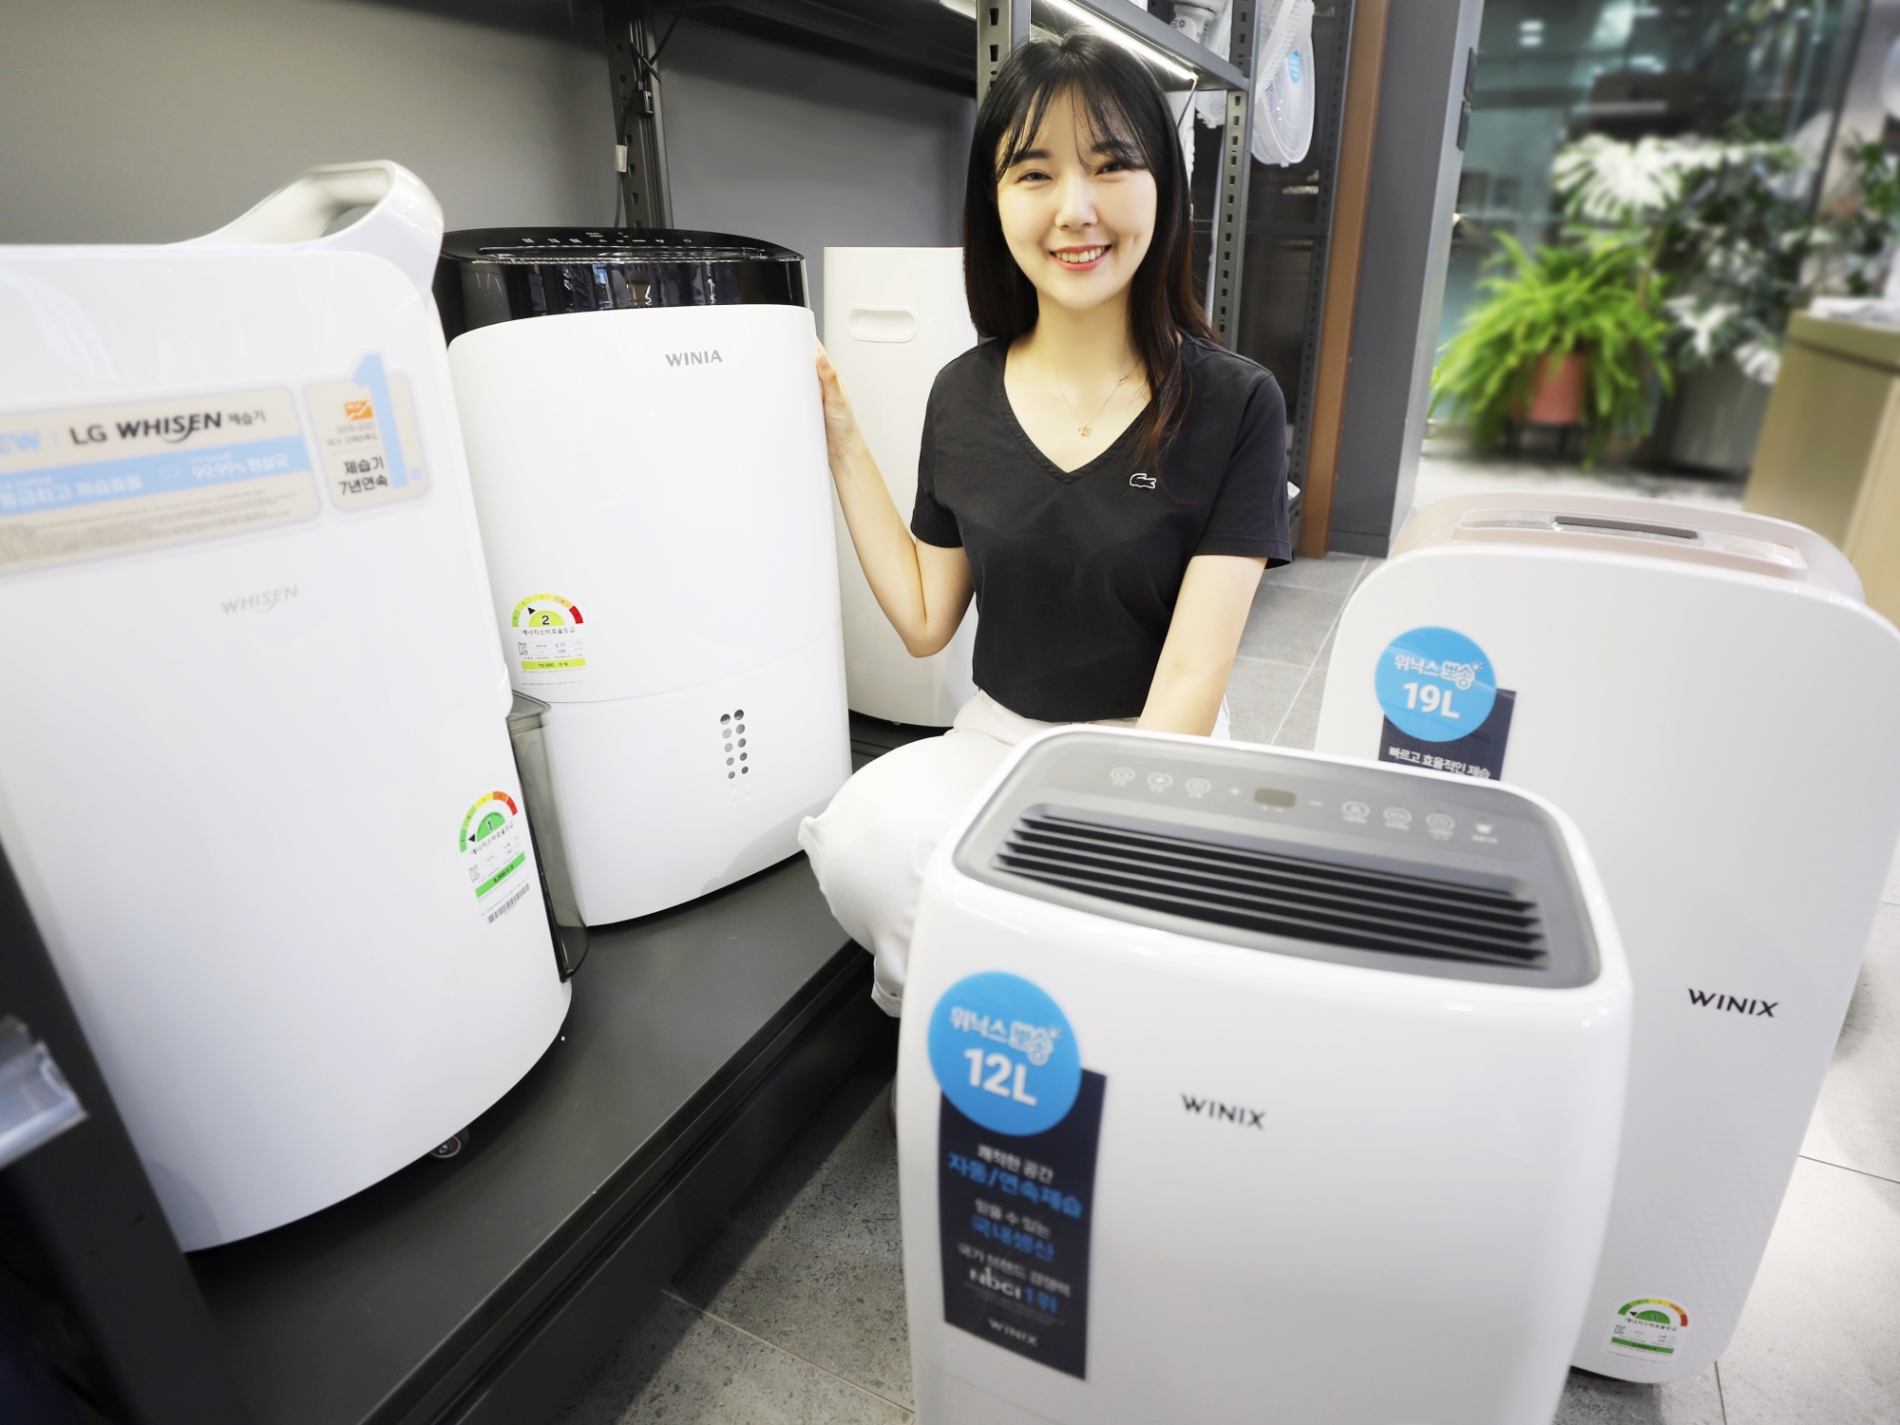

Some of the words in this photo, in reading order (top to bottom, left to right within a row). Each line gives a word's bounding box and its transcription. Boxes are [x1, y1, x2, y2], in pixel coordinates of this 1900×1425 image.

[664, 349, 723, 367] WINIA
[70, 424, 107, 445] LG
[116, 411, 222, 444] WHISEN
[228, 410, 266, 426] 제습기
[343, 456, 385, 475] 제습기
[338, 475, 389, 496] 7년연속
[221, 584, 298, 614] WHISEN
[541, 615, 550, 626] 2
[1394, 654, 1440, 678] 위닉스
[1403, 682, 1461, 719] 19L
[1389, 746, 1421, 764] 빠르고
[1421, 754, 1467, 775] 효율적인
[1687, 987, 1779, 1018] WINIX
[949, 1006, 1008, 1044] 위닉스
[964, 1048, 1038, 1107] 12L
[1180, 1093, 1266, 1131] WINIX
[987, 1316, 1038, 1348] WINIX
